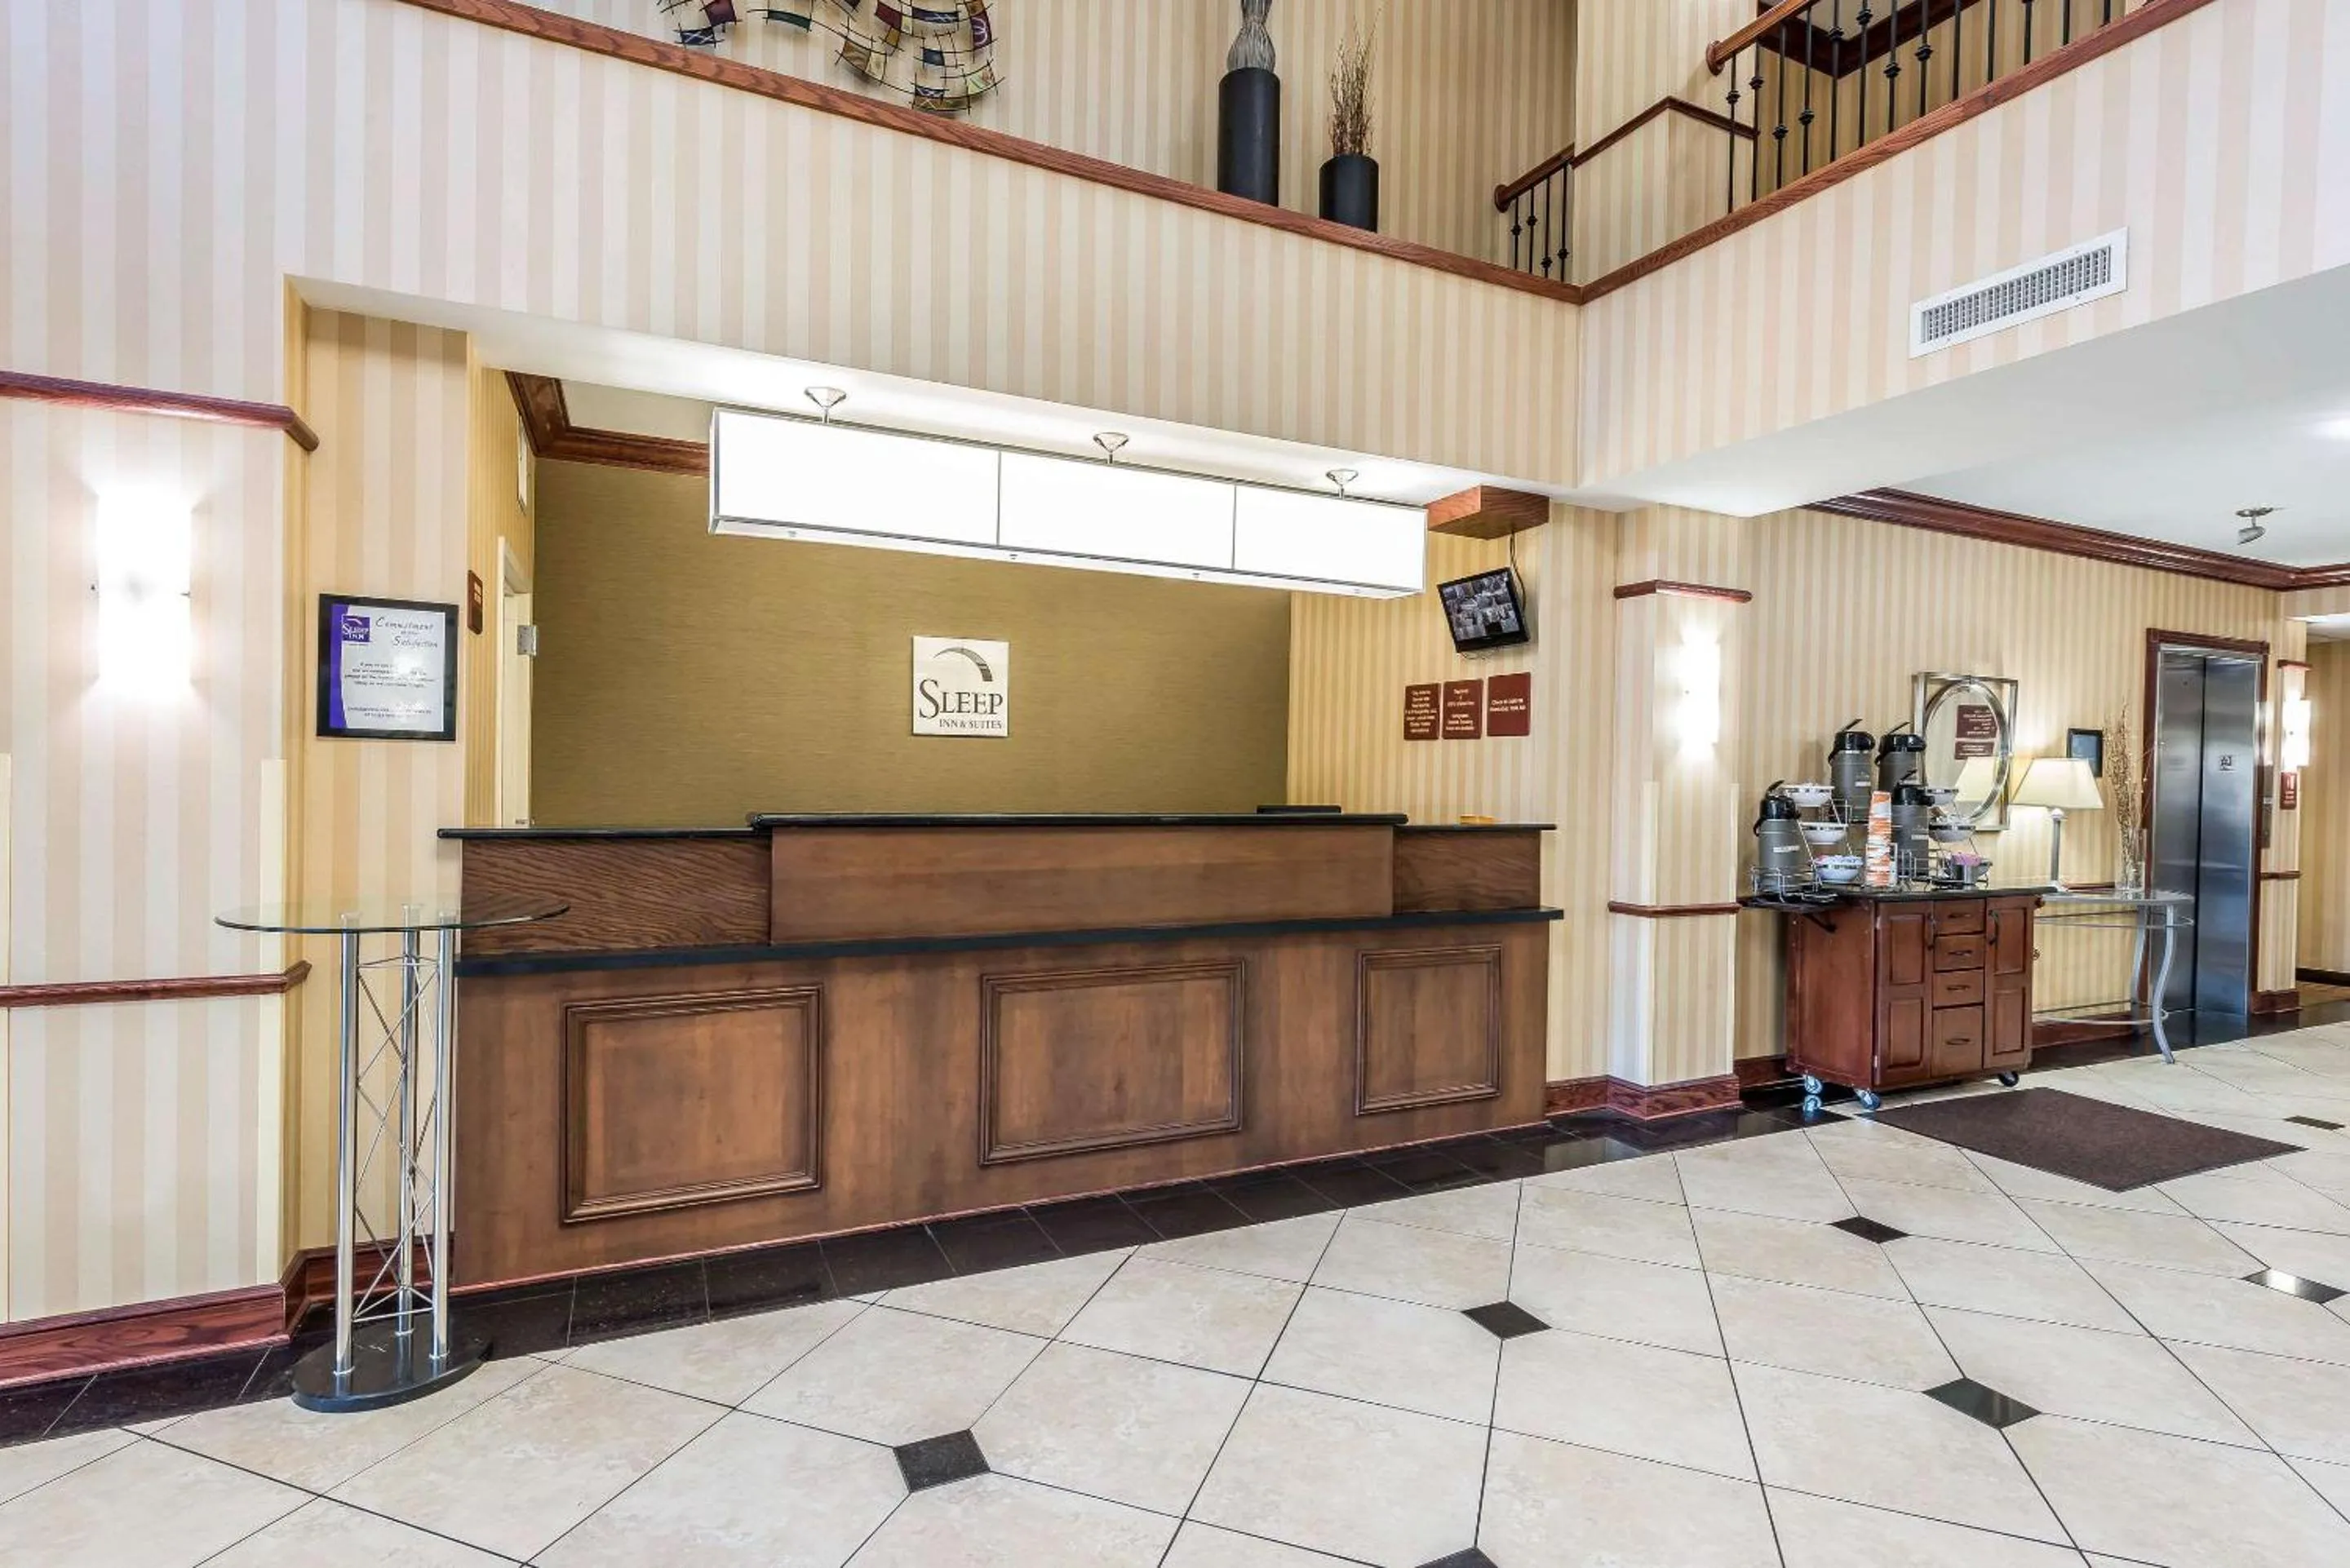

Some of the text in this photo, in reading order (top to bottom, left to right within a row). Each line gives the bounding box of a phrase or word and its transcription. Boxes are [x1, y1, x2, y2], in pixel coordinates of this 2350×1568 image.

[919, 678, 1004, 719] SLEEP
[939, 718, 958, 728] INN
[968, 720, 1003, 729] SUITES
